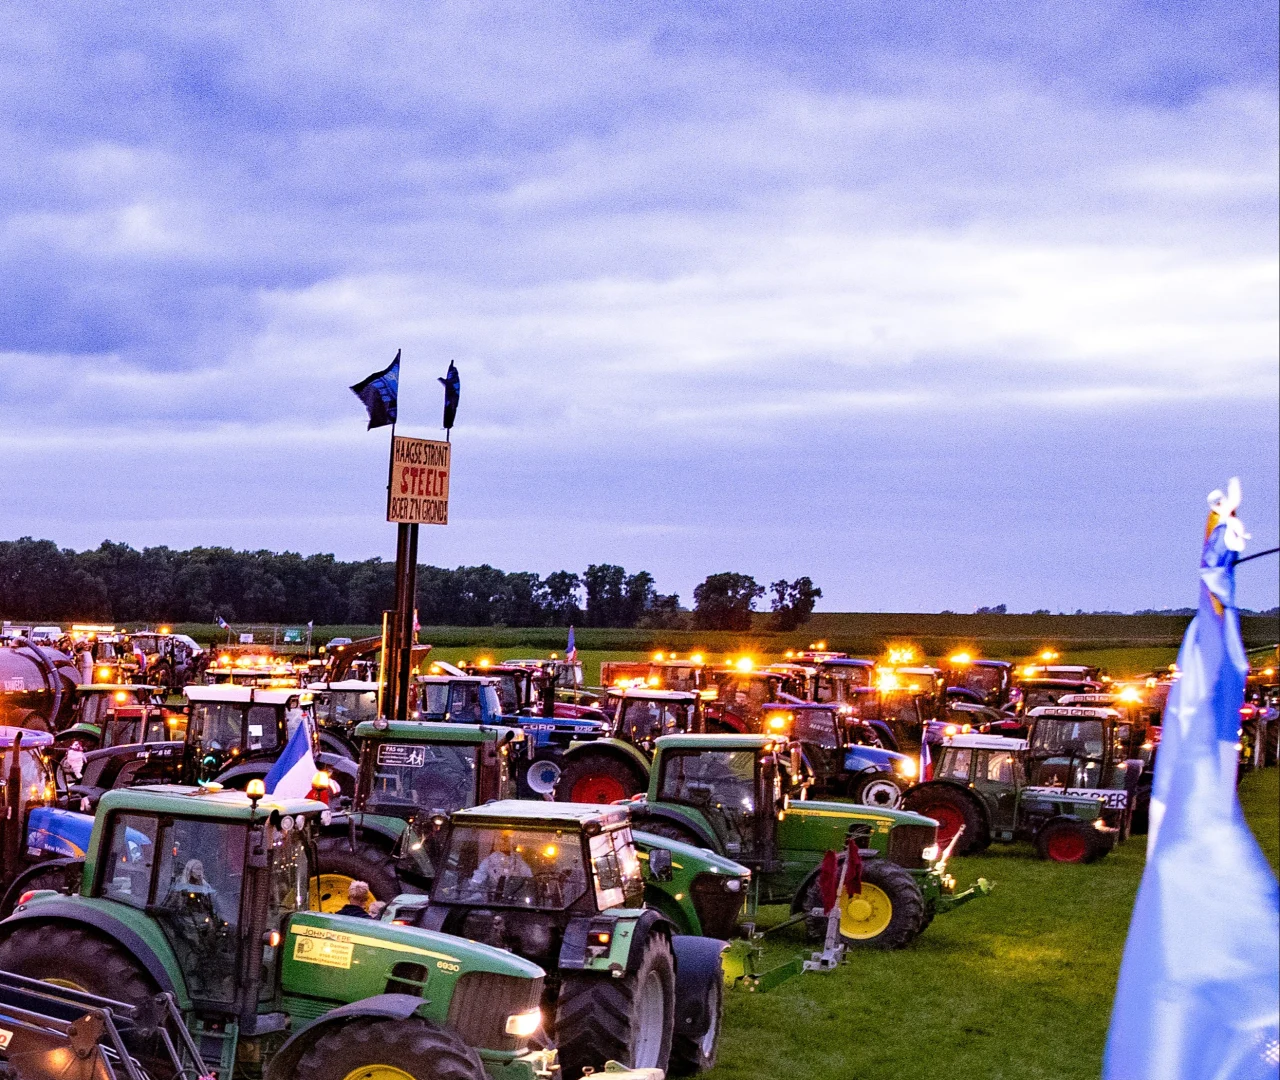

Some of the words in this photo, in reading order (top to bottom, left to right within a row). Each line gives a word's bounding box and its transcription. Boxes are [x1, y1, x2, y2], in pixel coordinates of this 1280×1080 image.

[400, 466, 447, 496] STEELT
[391, 496, 408, 520] BOER
[303, 928, 325, 938] JOHN
[326, 931, 352, 943] DEERE
[436, 960, 460, 972] 6930
